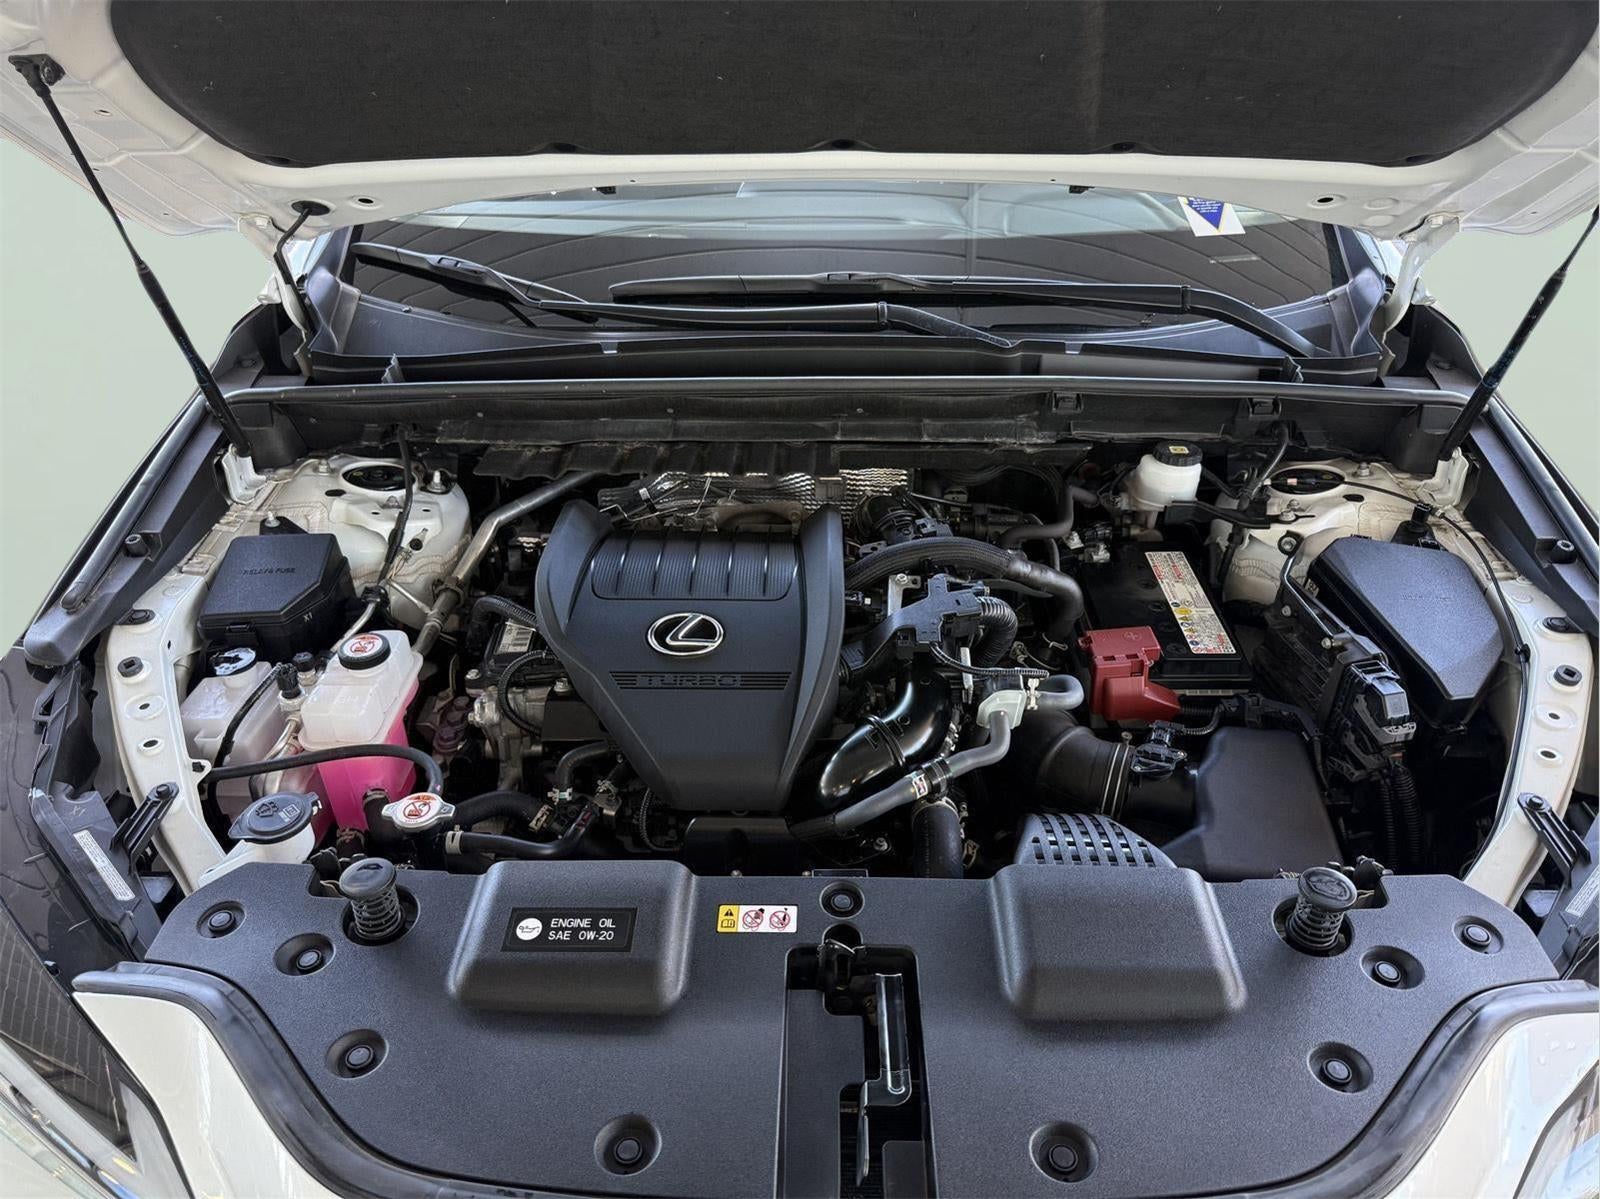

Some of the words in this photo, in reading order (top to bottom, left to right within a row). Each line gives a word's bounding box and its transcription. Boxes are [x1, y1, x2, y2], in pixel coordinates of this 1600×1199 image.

[639, 673, 740, 688] TURBO
[550, 917, 592, 928] ENGINE
[598, 917, 616, 928] OIL
[548, 930, 572, 940] SAE
[578, 930, 615, 940] 0W-20
